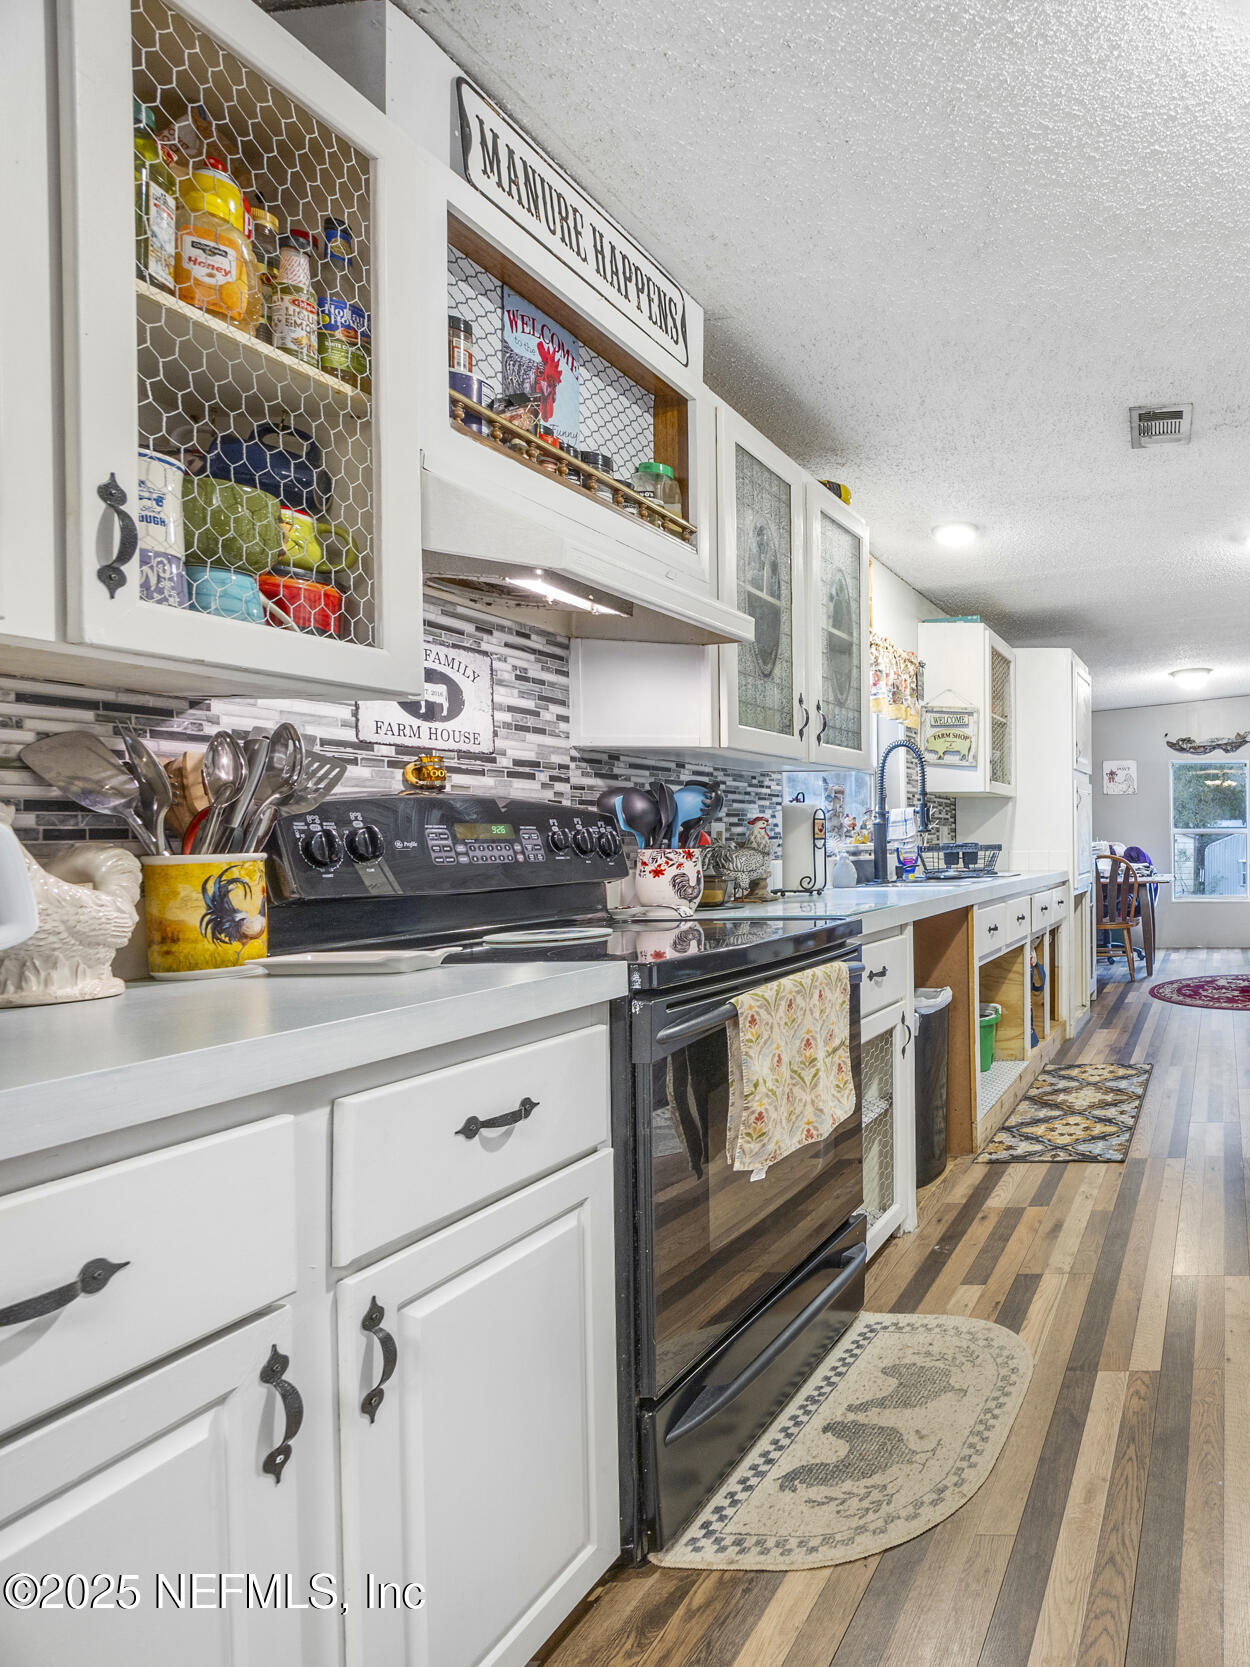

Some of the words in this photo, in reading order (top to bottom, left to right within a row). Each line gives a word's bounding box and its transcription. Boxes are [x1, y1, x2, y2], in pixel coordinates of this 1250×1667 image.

[475, 114, 589, 265] MANURE
[589, 222, 680, 346] HAPPENS
[187, 255, 231, 278] Honey
[514, 337, 523, 348] to
[523, 341, 536, 356] the
[550, 423, 579, 446] Funny
[138, 513, 167, 527] OUGH
[424, 648, 480, 683] FAMILY
[933, 715, 966, 725] WELCOME
[374, 720, 422, 740] FARM
[428, 726, 481, 746] HOUSE
[933, 733, 951, 741] FARM
[952, 733, 970, 742] SHOP
